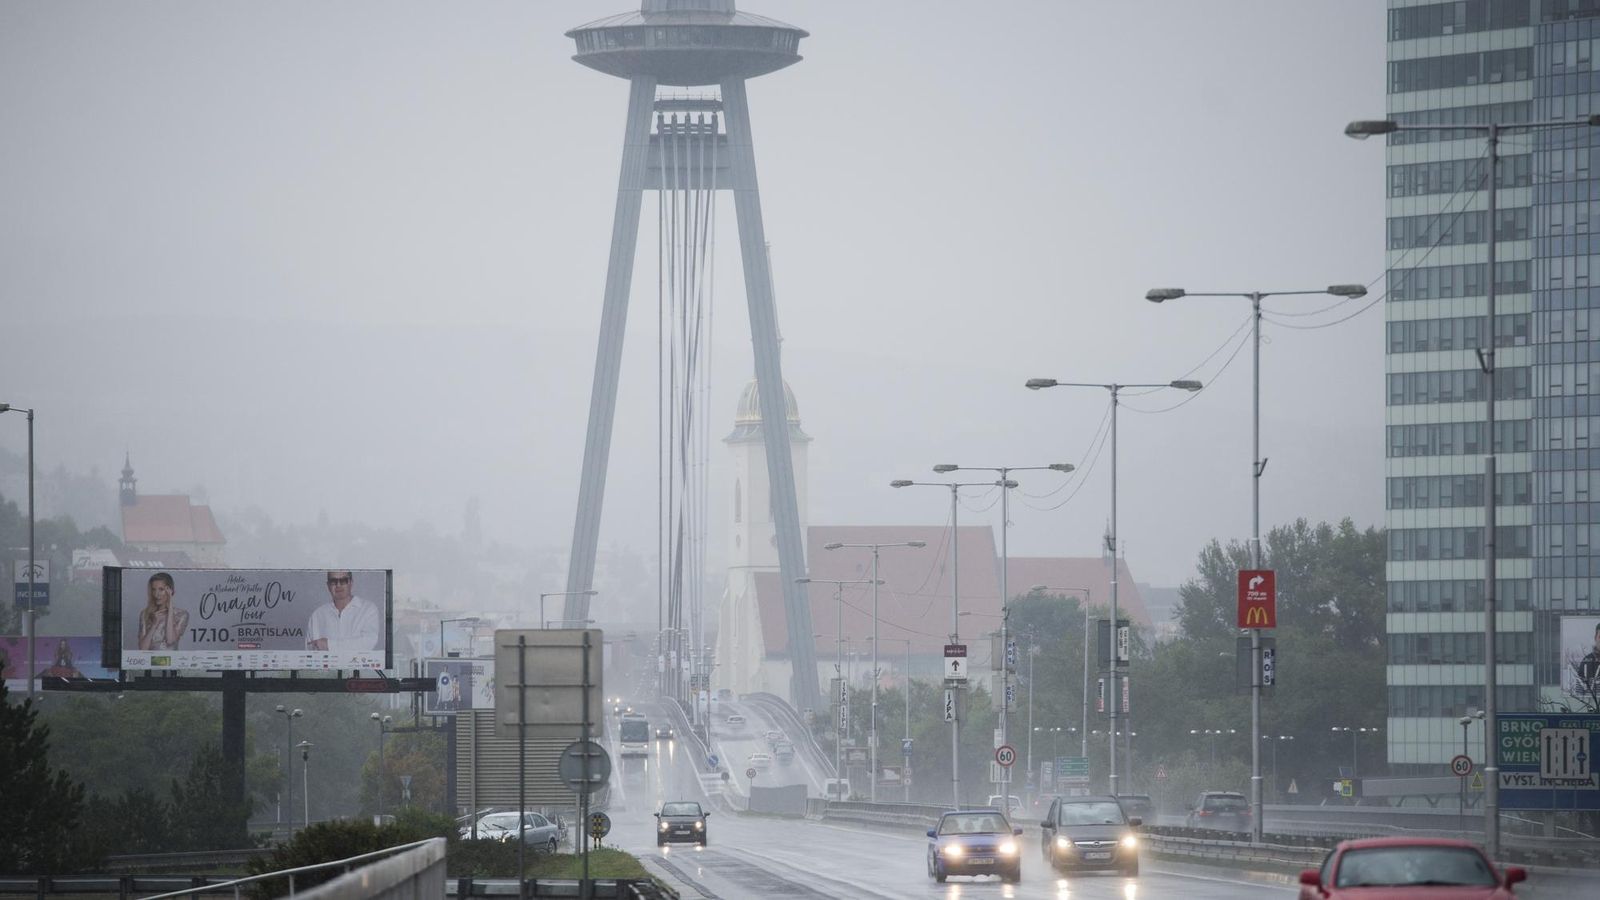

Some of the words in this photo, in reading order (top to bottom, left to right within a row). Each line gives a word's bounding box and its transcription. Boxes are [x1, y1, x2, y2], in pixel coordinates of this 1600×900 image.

[264, 581, 296, 609] On
[240, 602, 266, 623] Tour
[190, 628, 235, 642] 17.10.
[238, 627, 303, 637] BRATISLAVA
[1501, 721, 1543, 732] BRNO
[1000, 751, 1012, 761] 60
[1502, 751, 1541, 762] WIEN
[1456, 761, 1468, 771] 60
